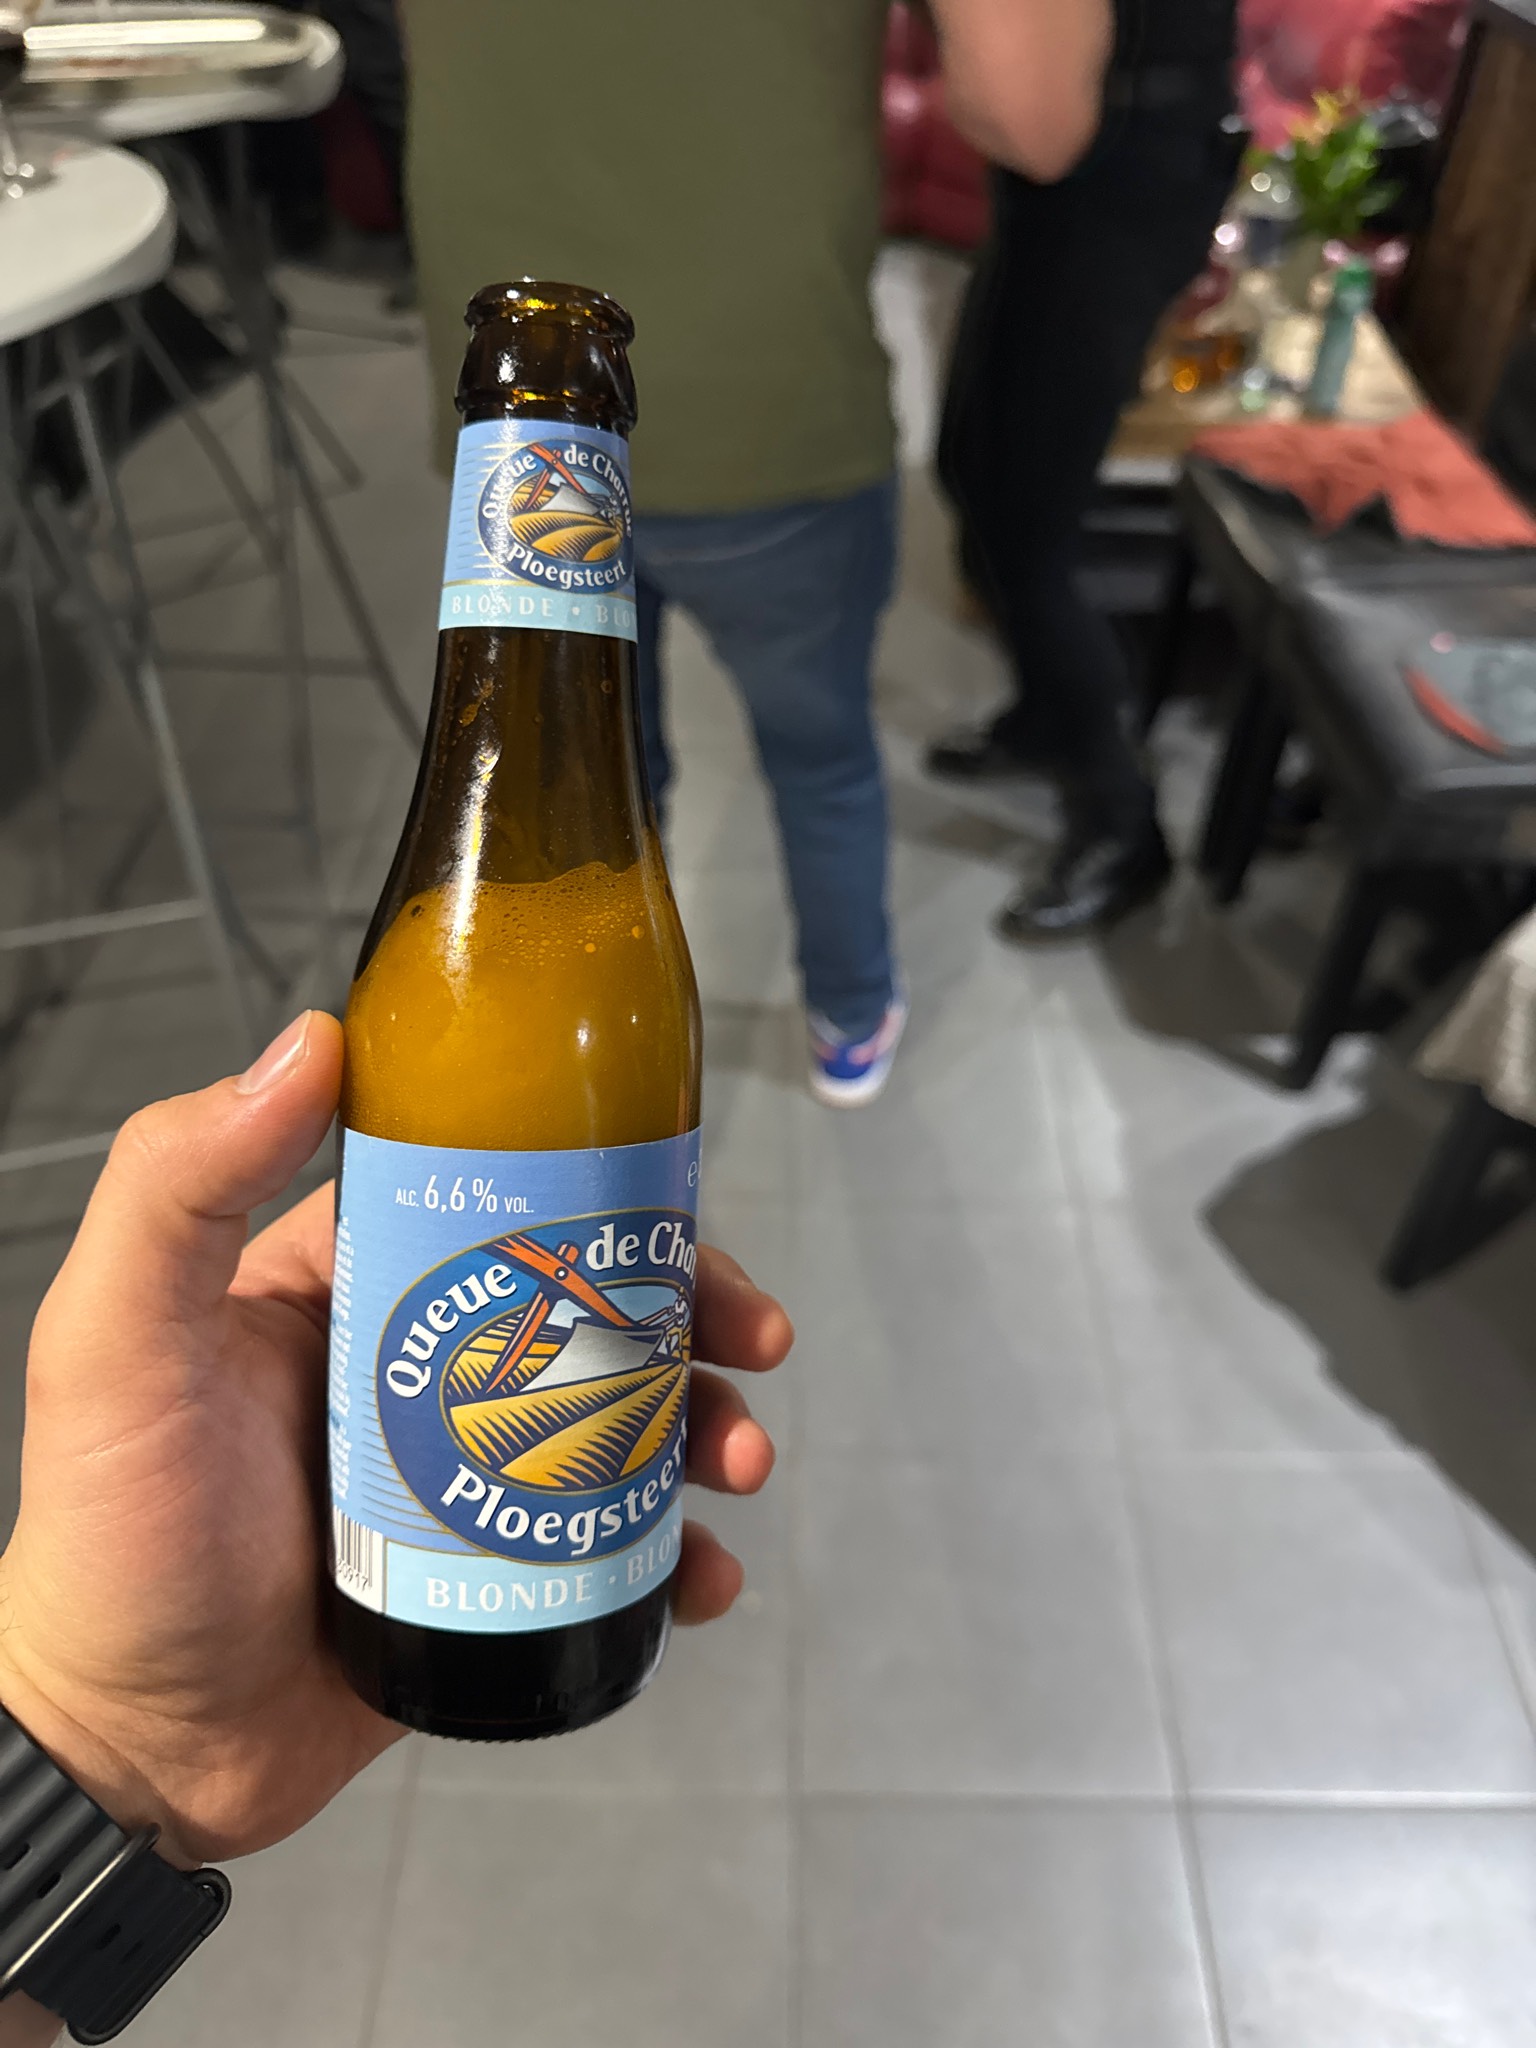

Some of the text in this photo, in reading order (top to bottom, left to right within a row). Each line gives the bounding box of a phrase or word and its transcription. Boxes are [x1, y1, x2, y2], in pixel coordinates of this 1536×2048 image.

[564, 444, 589, 468] de
[507, 541, 626, 590] Ploegsteert
[451, 595, 554, 617] BLONDE
[395, 1187, 419, 1208] ALC.
[504, 1196, 535, 1214] VOL.
[386, 1221, 697, 1398] Queue de Cha
[440, 1416, 688, 1556] Ploegsteert
[425, 1572, 593, 1613] BLONDE
